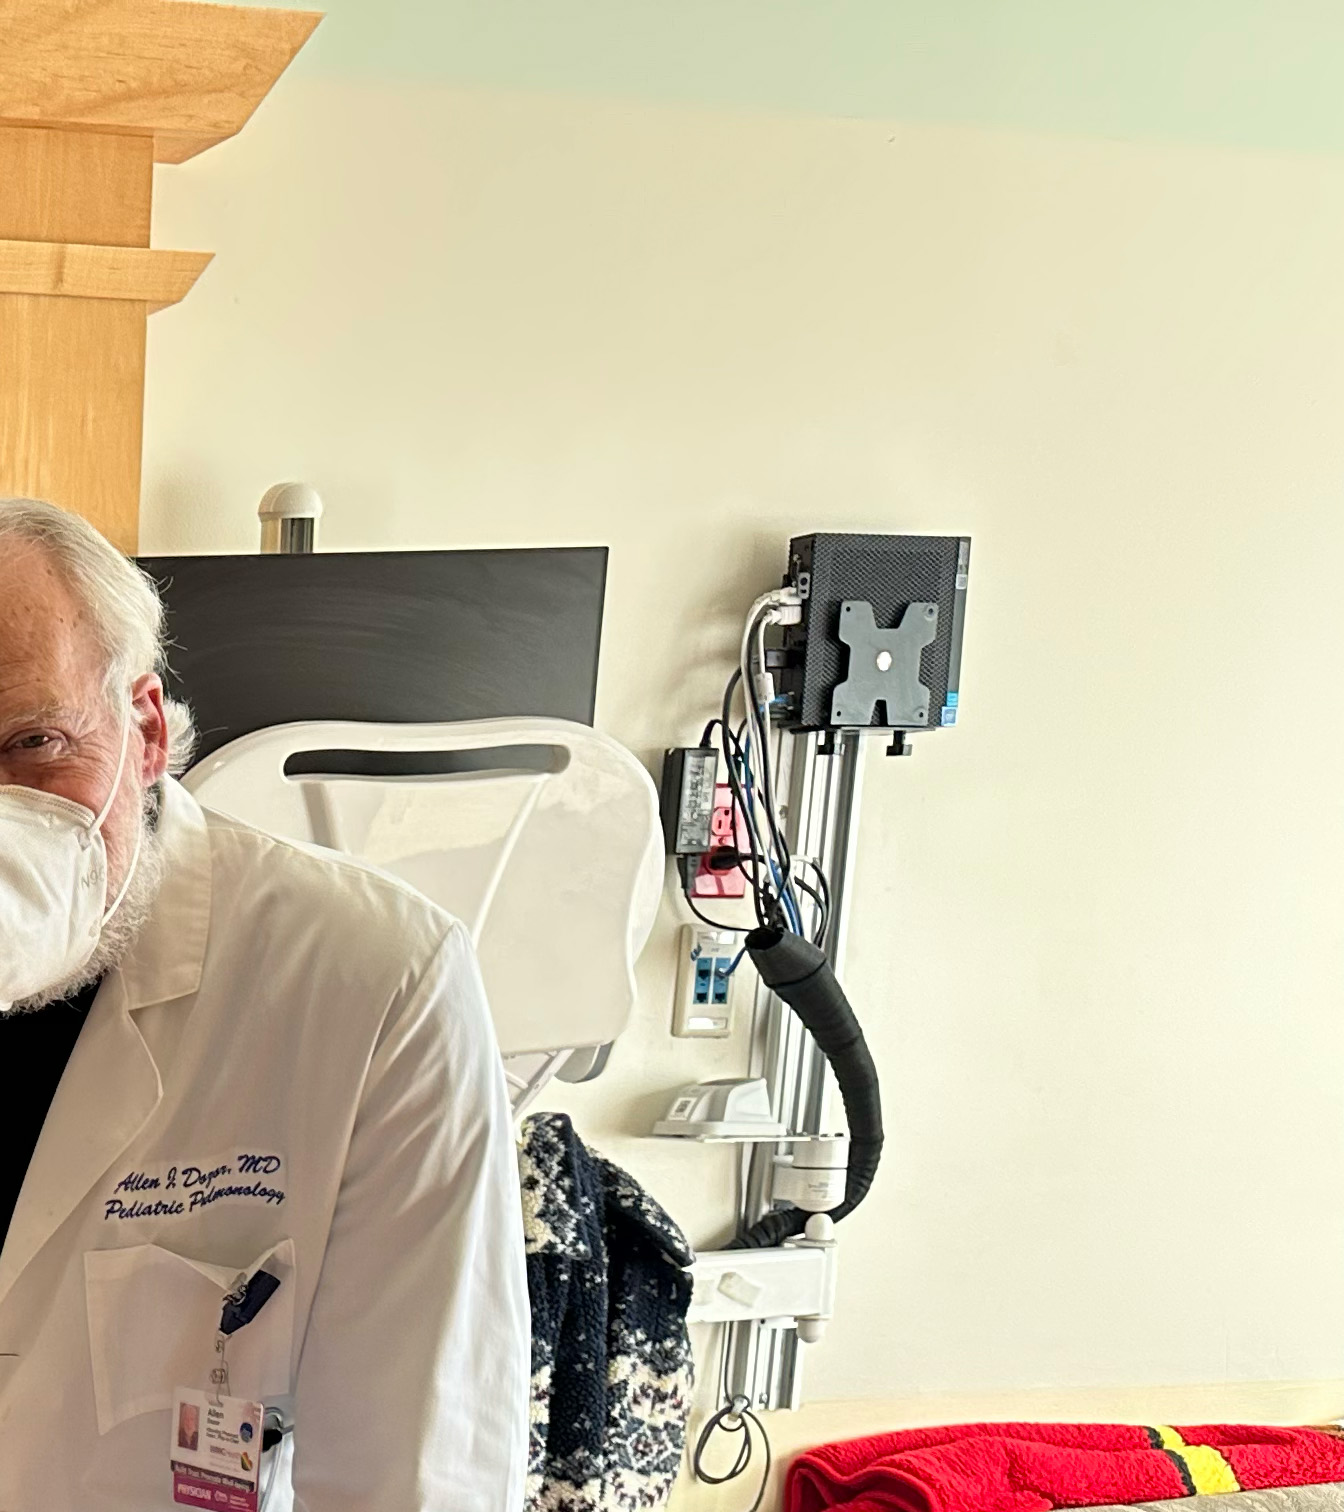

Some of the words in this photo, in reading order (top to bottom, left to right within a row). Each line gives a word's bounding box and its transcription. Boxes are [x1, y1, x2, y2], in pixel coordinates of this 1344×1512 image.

[113, 1171, 161, 1195] Allen
[237, 1153, 281, 1175] MD
[104, 1198, 185, 1221] Pediatric
[188, 1181, 286, 1213] Pulmonology
